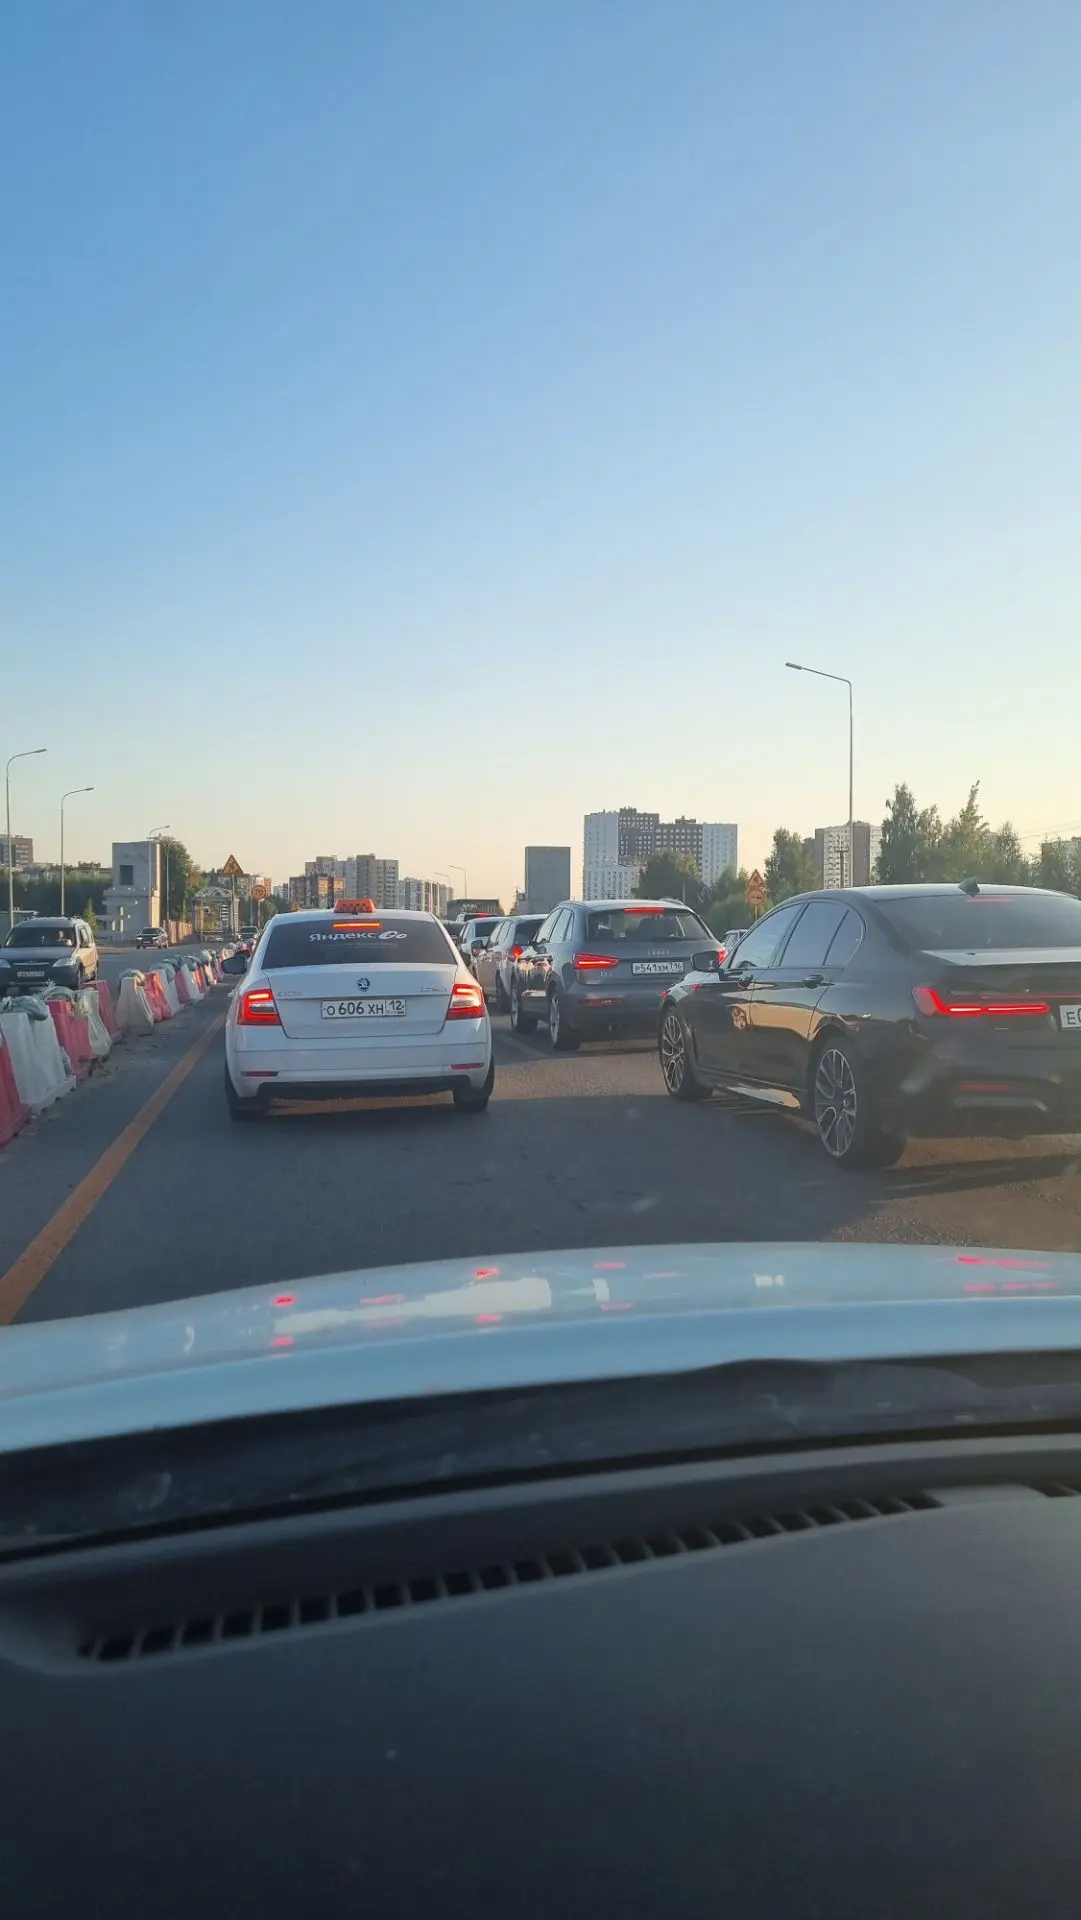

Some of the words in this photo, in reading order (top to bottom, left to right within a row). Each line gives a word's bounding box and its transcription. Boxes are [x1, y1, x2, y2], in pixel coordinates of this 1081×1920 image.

[309, 931, 377, 941] Яндекс
[379, 930, 407, 940] Go
[389, 1001, 402, 1010] 12
